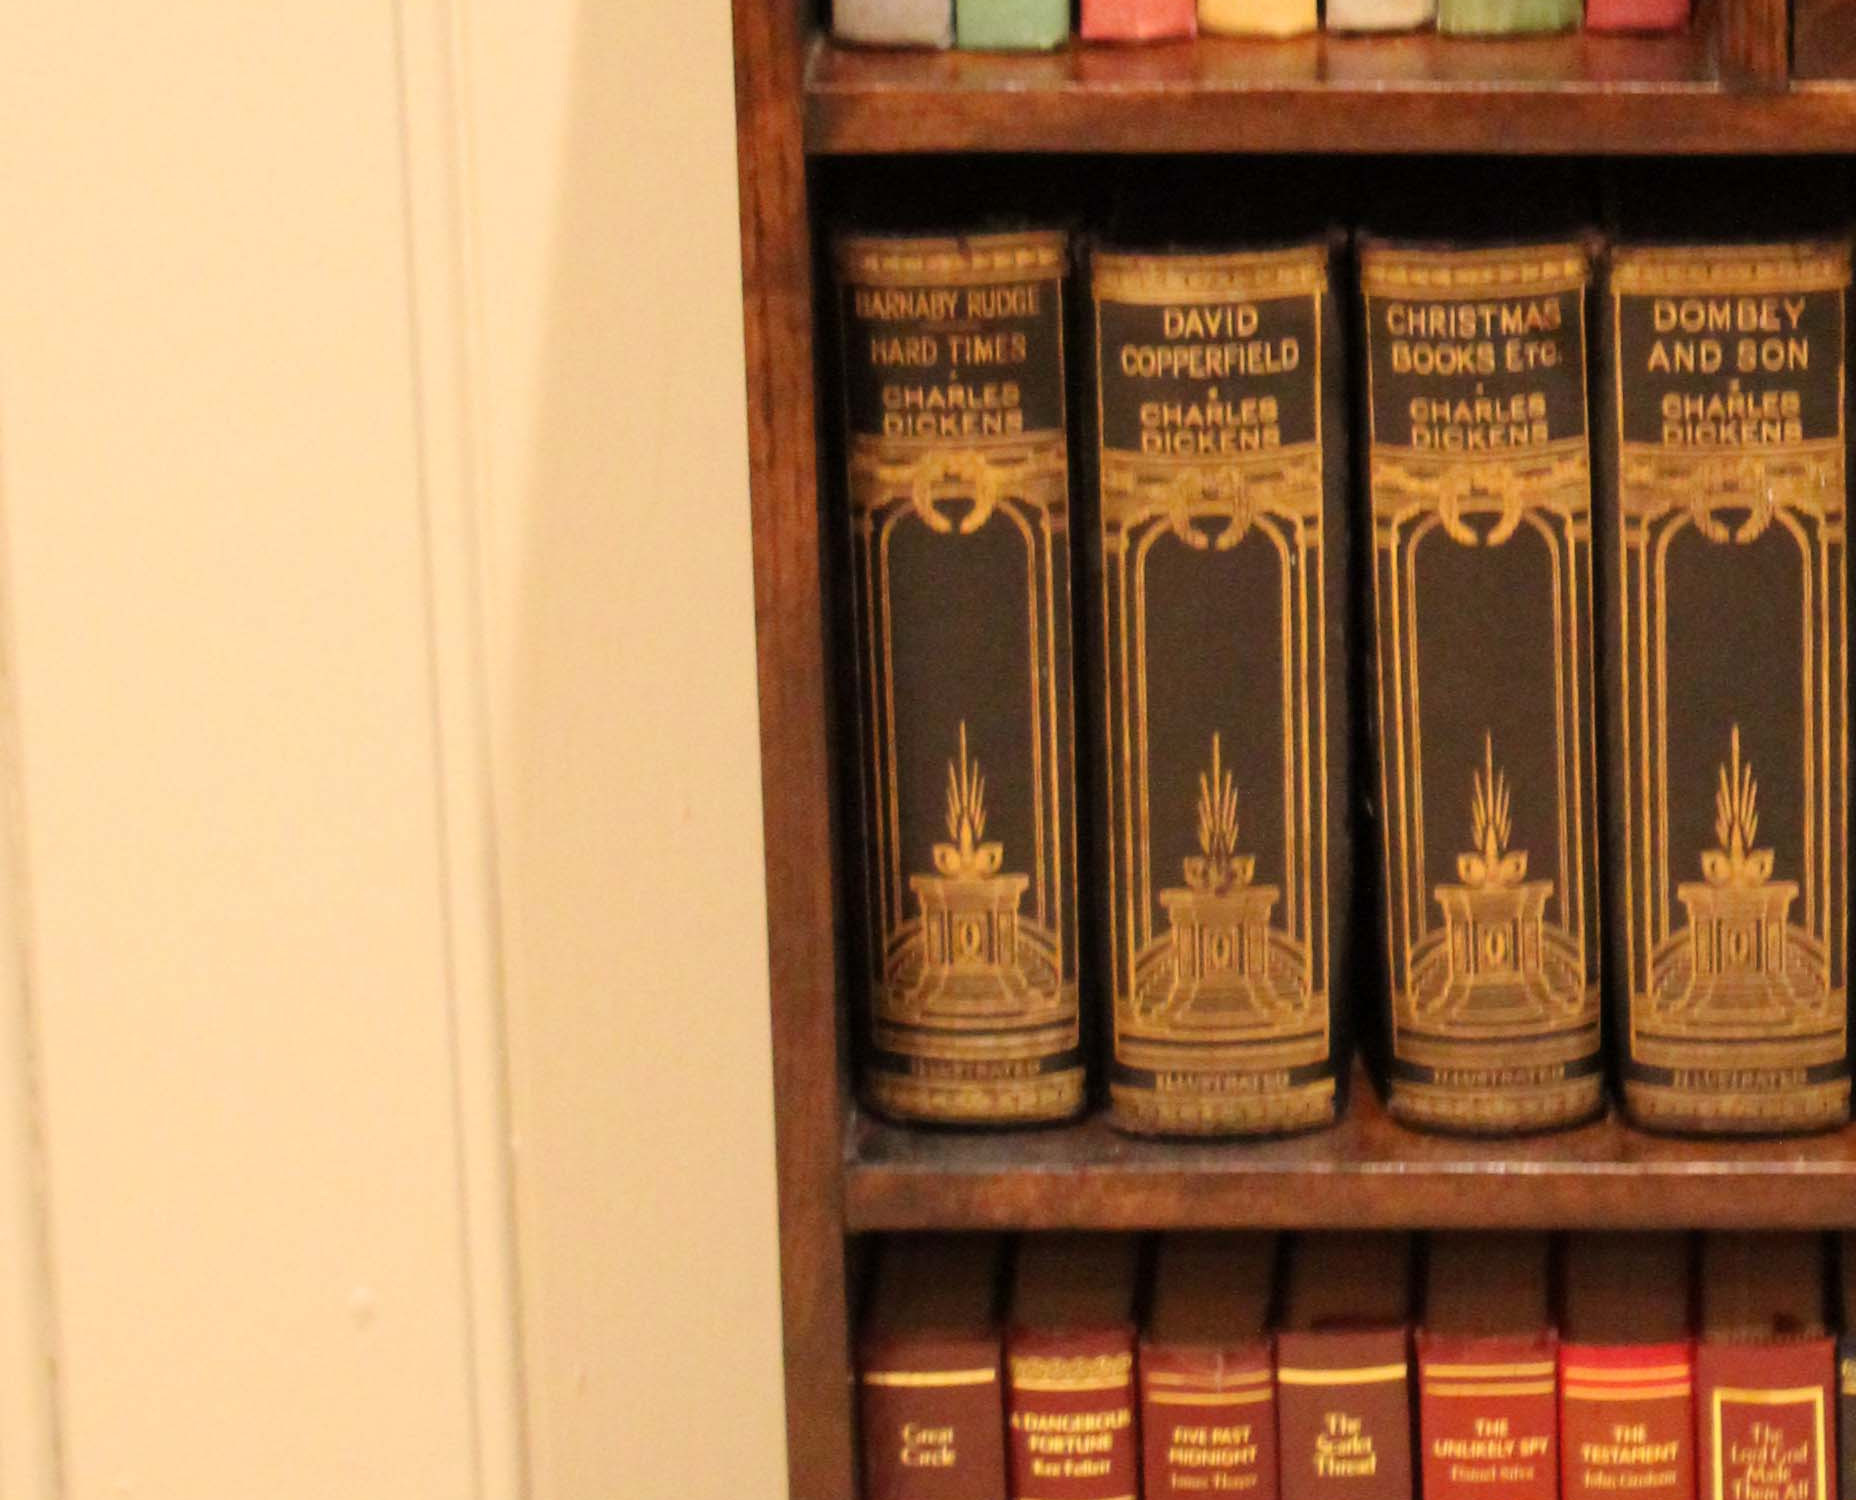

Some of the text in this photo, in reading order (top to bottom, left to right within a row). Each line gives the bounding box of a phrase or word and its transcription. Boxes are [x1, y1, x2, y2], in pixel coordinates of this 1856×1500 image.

[856, 287, 959, 320] BARNABY
[1386, 299, 1562, 338] CHRISTMAS
[1653, 298, 1807, 333] DOMBEY
[1162, 305, 1259, 341] DAVID
[870, 333, 1027, 366] HARD TIMES
[1121, 339, 1299, 379] COPPERFIELD
[1391, 340, 1494, 375] BOOKS
[1647, 339, 1810, 373] AND SON
[882, 383, 1020, 409] CHARLES
[1409, 392, 1547, 423] CHARLES
[1661, 392, 1800, 422] CHARLES
[882, 409, 1024, 436] DICKENS
[1140, 398, 1279, 428] CHARLES
[1140, 428, 1281, 455] DICKENS
[1411, 421, 1549, 449] DICKENS
[1661, 420, 1802, 448] DICKENS
